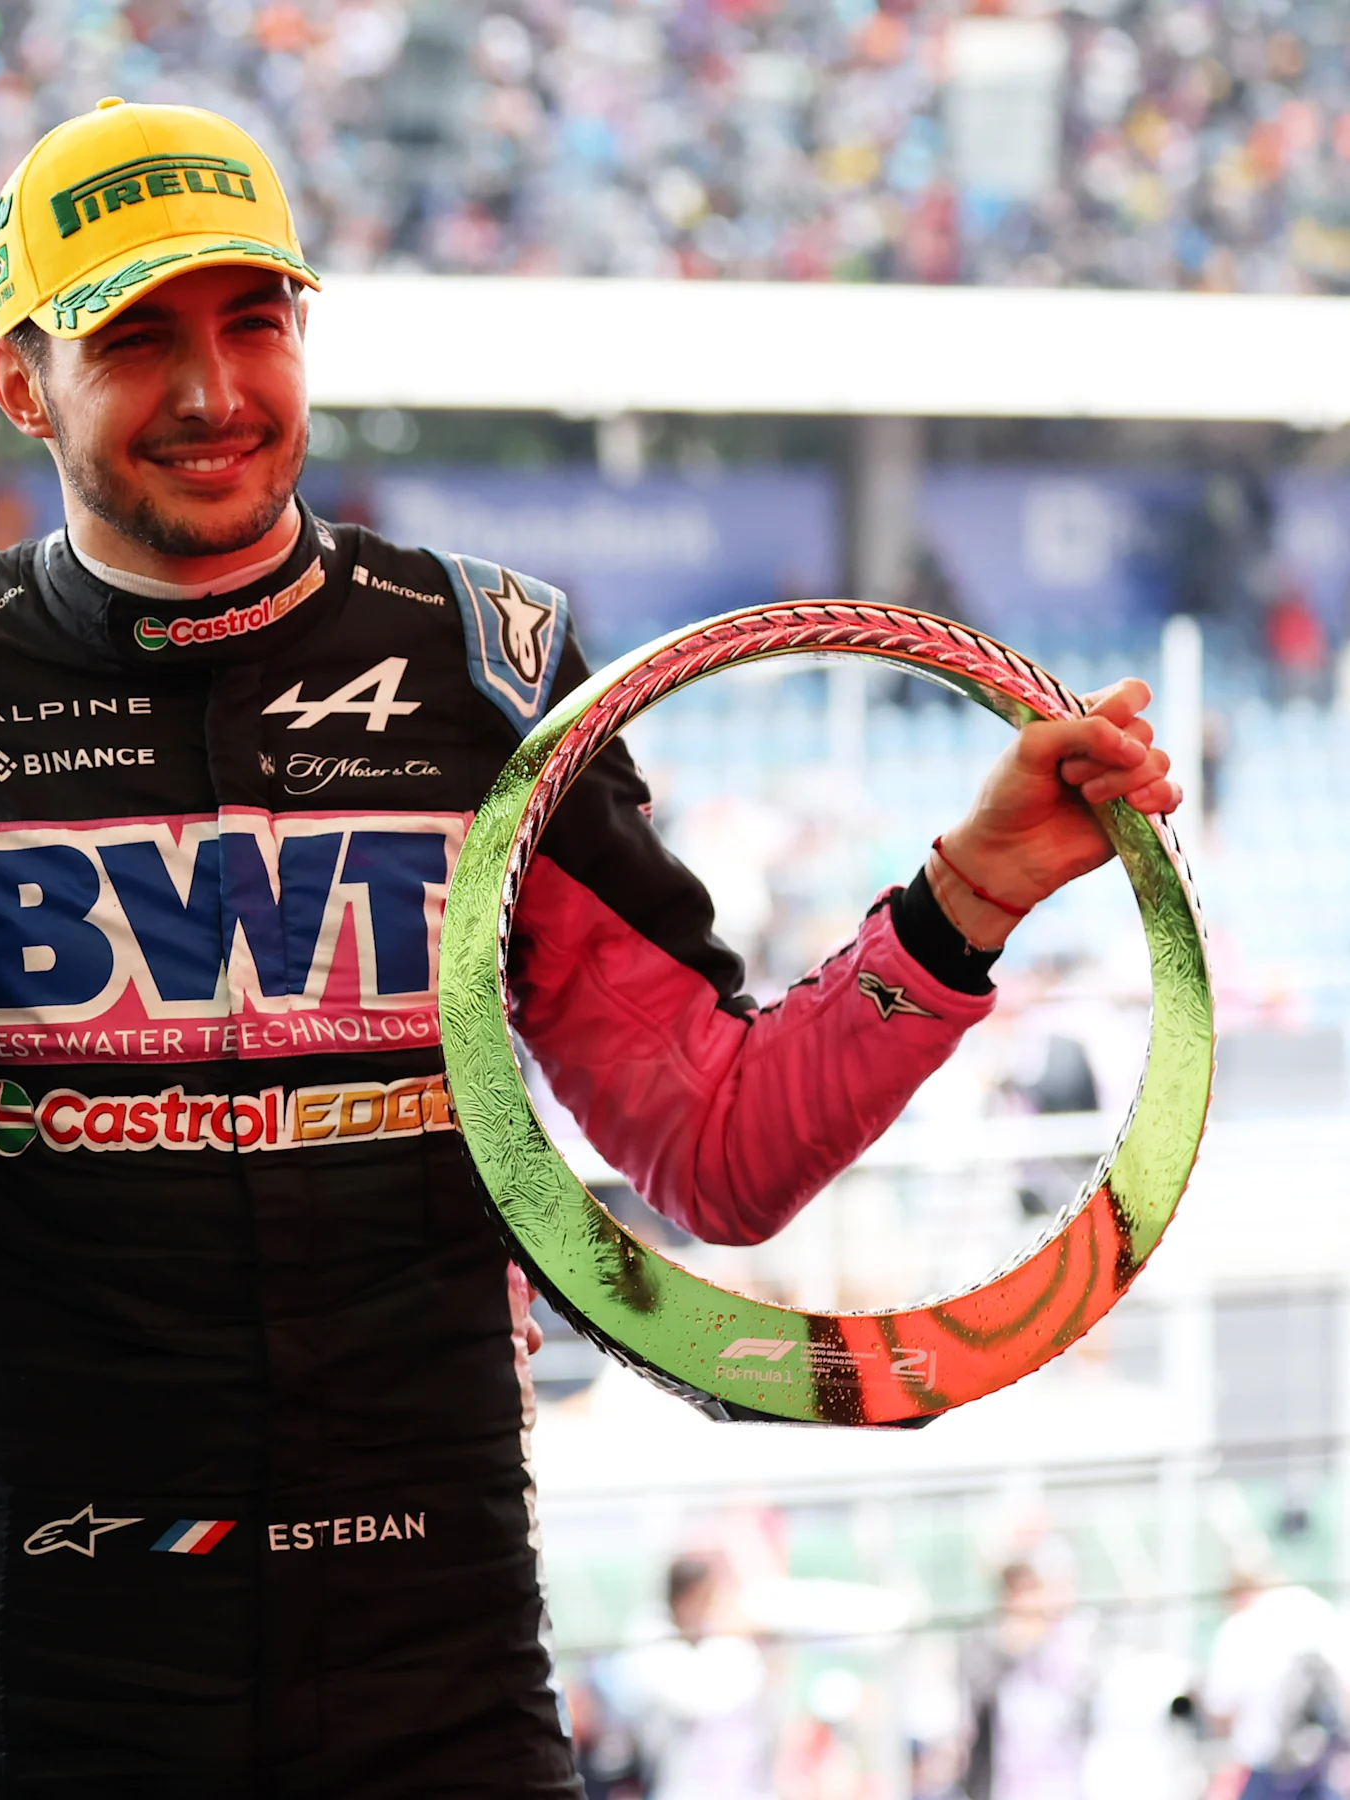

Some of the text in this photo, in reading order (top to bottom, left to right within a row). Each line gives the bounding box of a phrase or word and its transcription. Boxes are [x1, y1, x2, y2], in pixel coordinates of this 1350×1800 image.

[50, 152, 257, 239] PIRELLI
[370, 574, 446, 608] Microsoft
[170, 599, 270, 644] Castrol
[22, 747, 156, 778] BINANCE
[56, 1028, 186, 1057] WATER
[39, 1090, 279, 1148] Castrol
[715, 1365, 782, 1383] Formula
[268, 1512, 427, 1552] ESTEBAN
